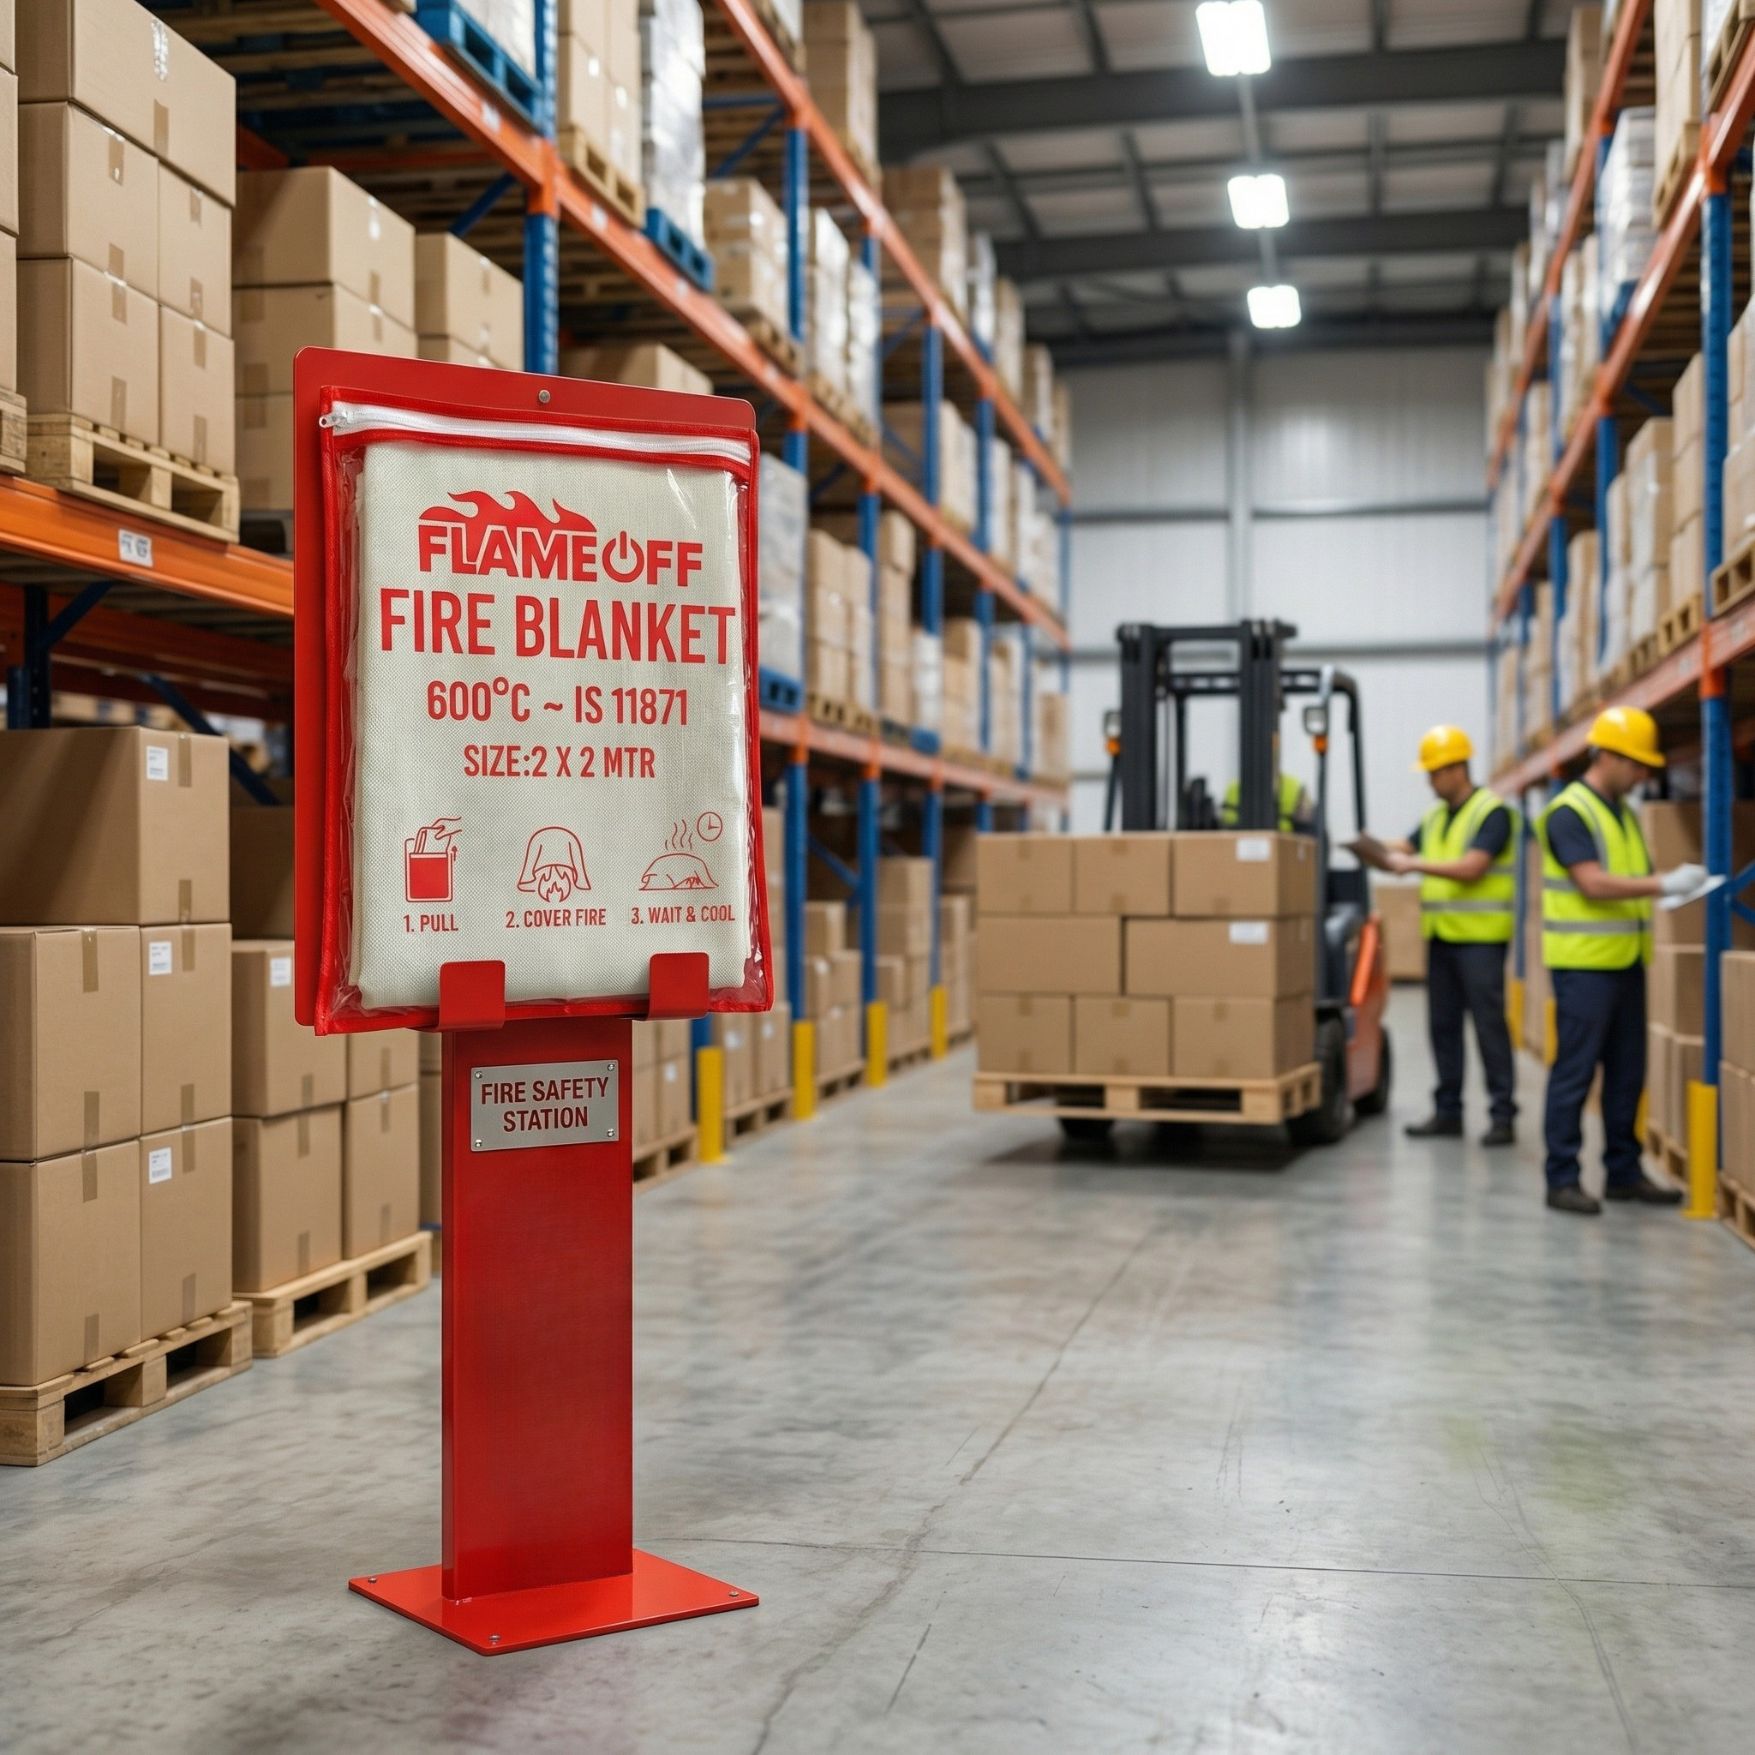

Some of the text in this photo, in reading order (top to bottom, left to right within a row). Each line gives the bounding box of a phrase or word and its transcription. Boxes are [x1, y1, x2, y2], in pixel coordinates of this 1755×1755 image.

[418, 524, 703, 587] FLAMEOFF
[380, 587, 736, 665] FIRE BLANKET
[426, 676, 531, 723] 600°C
[575, 686, 603, 725] IS
[611, 687, 688, 726] 11871
[463, 744, 656, 779] SIZE:2 X 2 MTR
[403, 913, 459, 933] 1. PULL
[505, 908, 607, 929] 2. COVER FIRE
[631, 904, 736, 925] 3. WAIT & COOL
[481, 1076, 609, 1105] FIRE SAFETY
[503, 1106, 588, 1133] STATION
